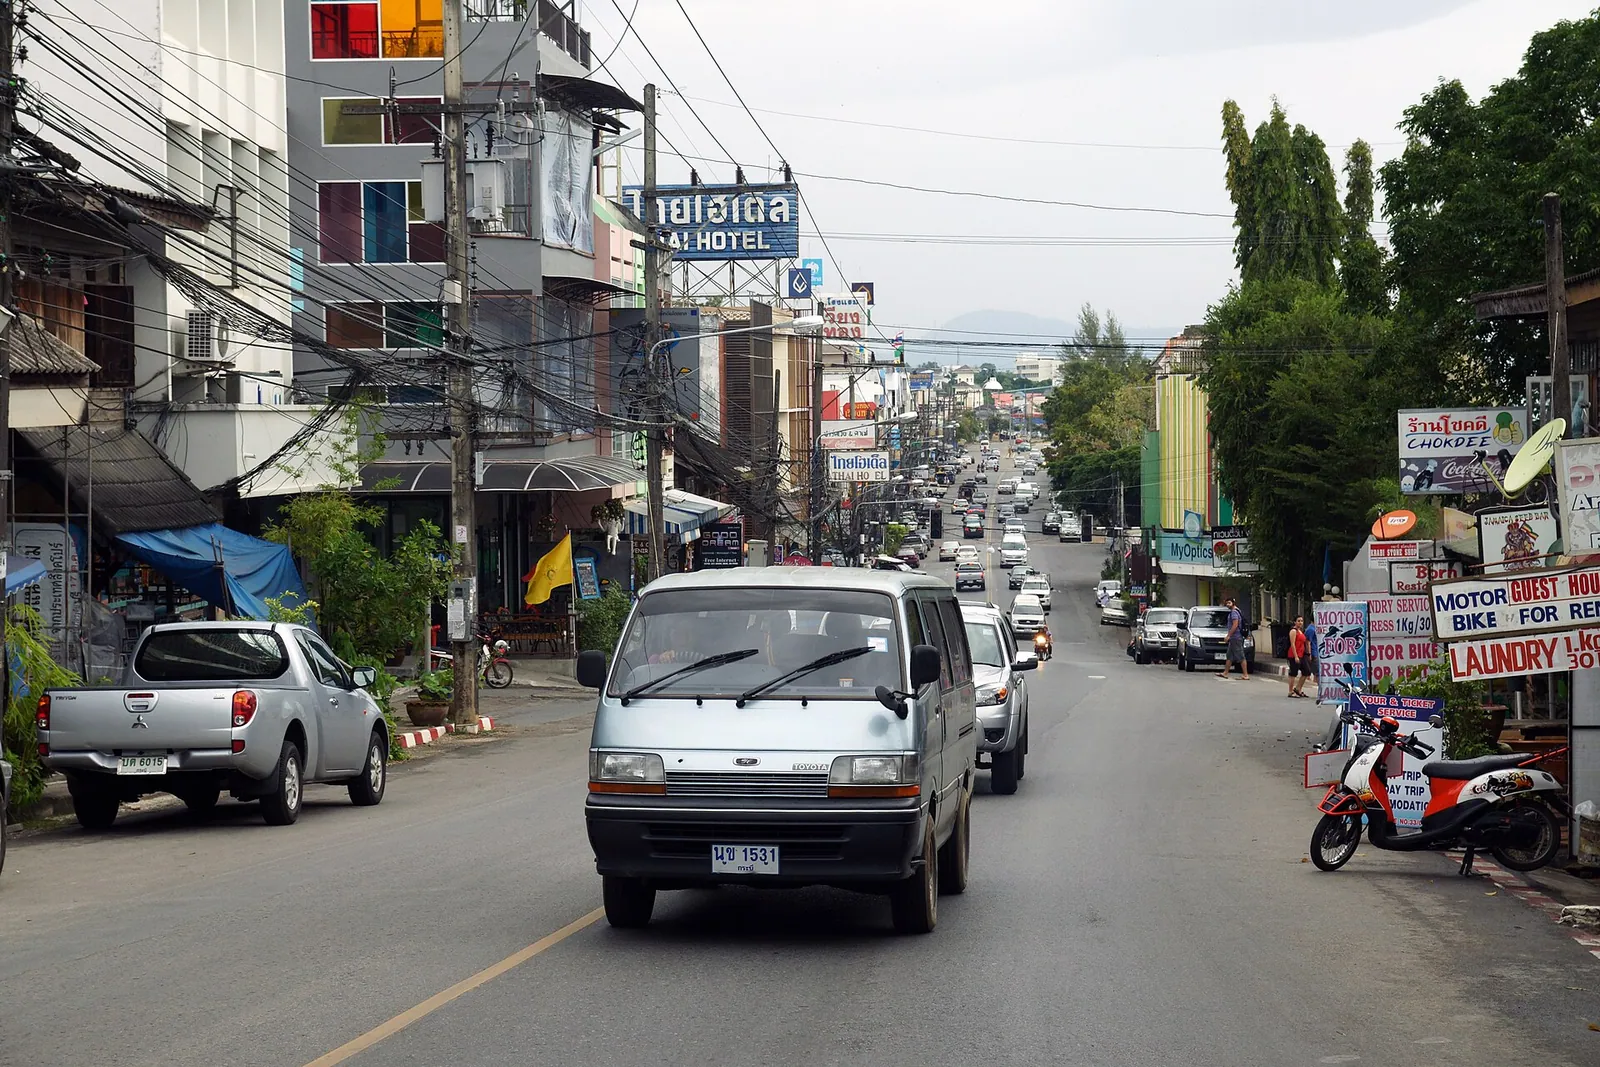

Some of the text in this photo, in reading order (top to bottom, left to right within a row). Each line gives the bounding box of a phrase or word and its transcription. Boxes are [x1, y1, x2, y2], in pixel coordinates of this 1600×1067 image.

[696, 231, 771, 250] HOTEL
[1408, 414, 1488, 436] ร้านโชคดี
[1407, 436, 1492, 449] CHOKDEE
[831, 454, 887, 469] ไทยโฮเต็ล
[832, 471, 886, 480] THAI HOEL
[1534, 511, 1549, 521] BAR
[1171, 543, 1213, 561] MyOptics
[1415, 565, 1457, 579] Born
[1510, 577, 1558, 603] GUEST
[1436, 588, 1508, 612] MOTOR
[1317, 611, 1364, 625] MOTOR
[1452, 611, 1497, 631] BIKE
[1519, 605, 1559, 624] FOR
[1370, 620, 1394, 632] RESS
[1324, 638, 1358, 655] FOR
[1409, 643, 1439, 660] BIKE
[1450, 637, 1558, 678] LAUNDRY
[1398, 665, 1429, 679] RET
[1361, 696, 1436, 709] TOUR & TICKET
[1378, 708, 1416, 718] SERVICE
[139, 758, 163, 767] 6015
[1402, 771, 1421, 781] TRIP
[1405, 786, 1425, 796] TRIP
[742, 848, 775, 862] 1531
